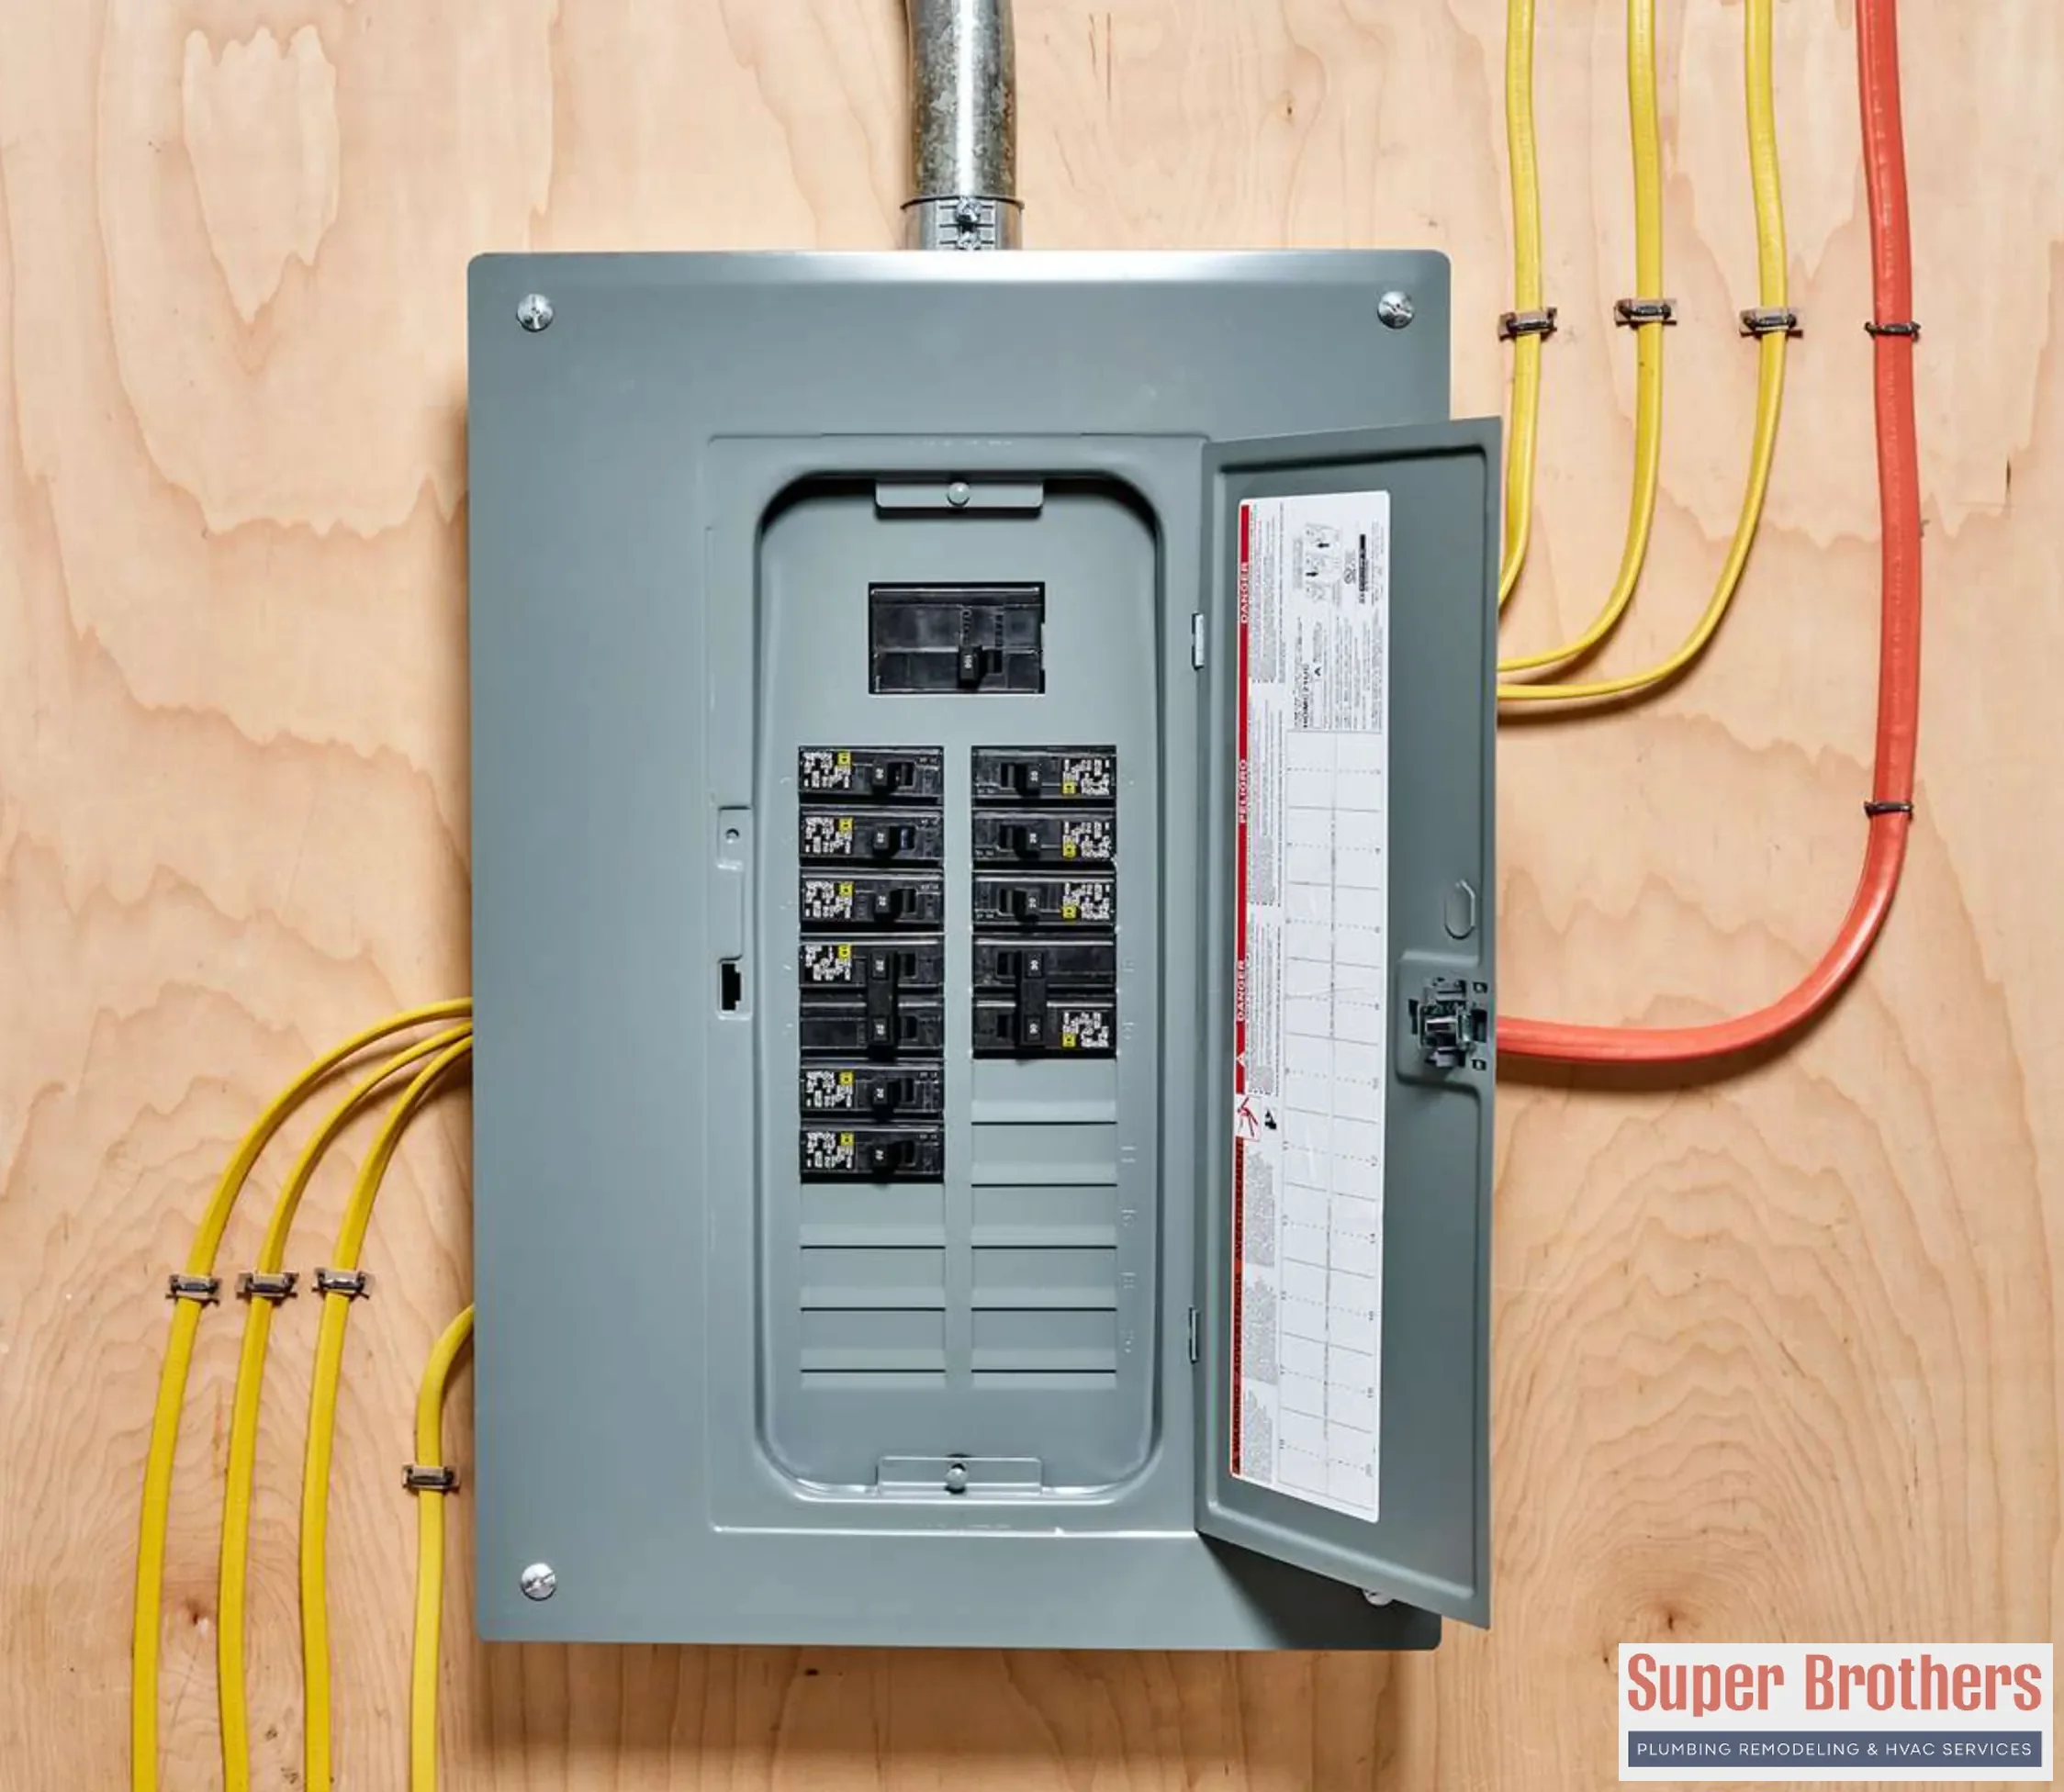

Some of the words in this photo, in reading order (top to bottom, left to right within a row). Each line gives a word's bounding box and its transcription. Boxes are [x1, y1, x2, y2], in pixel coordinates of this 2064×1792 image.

[1240, 561, 1249, 624] DANGER
[1239, 759, 1247, 823] PELIGRO
[1237, 959, 1245, 1022] DANGER
